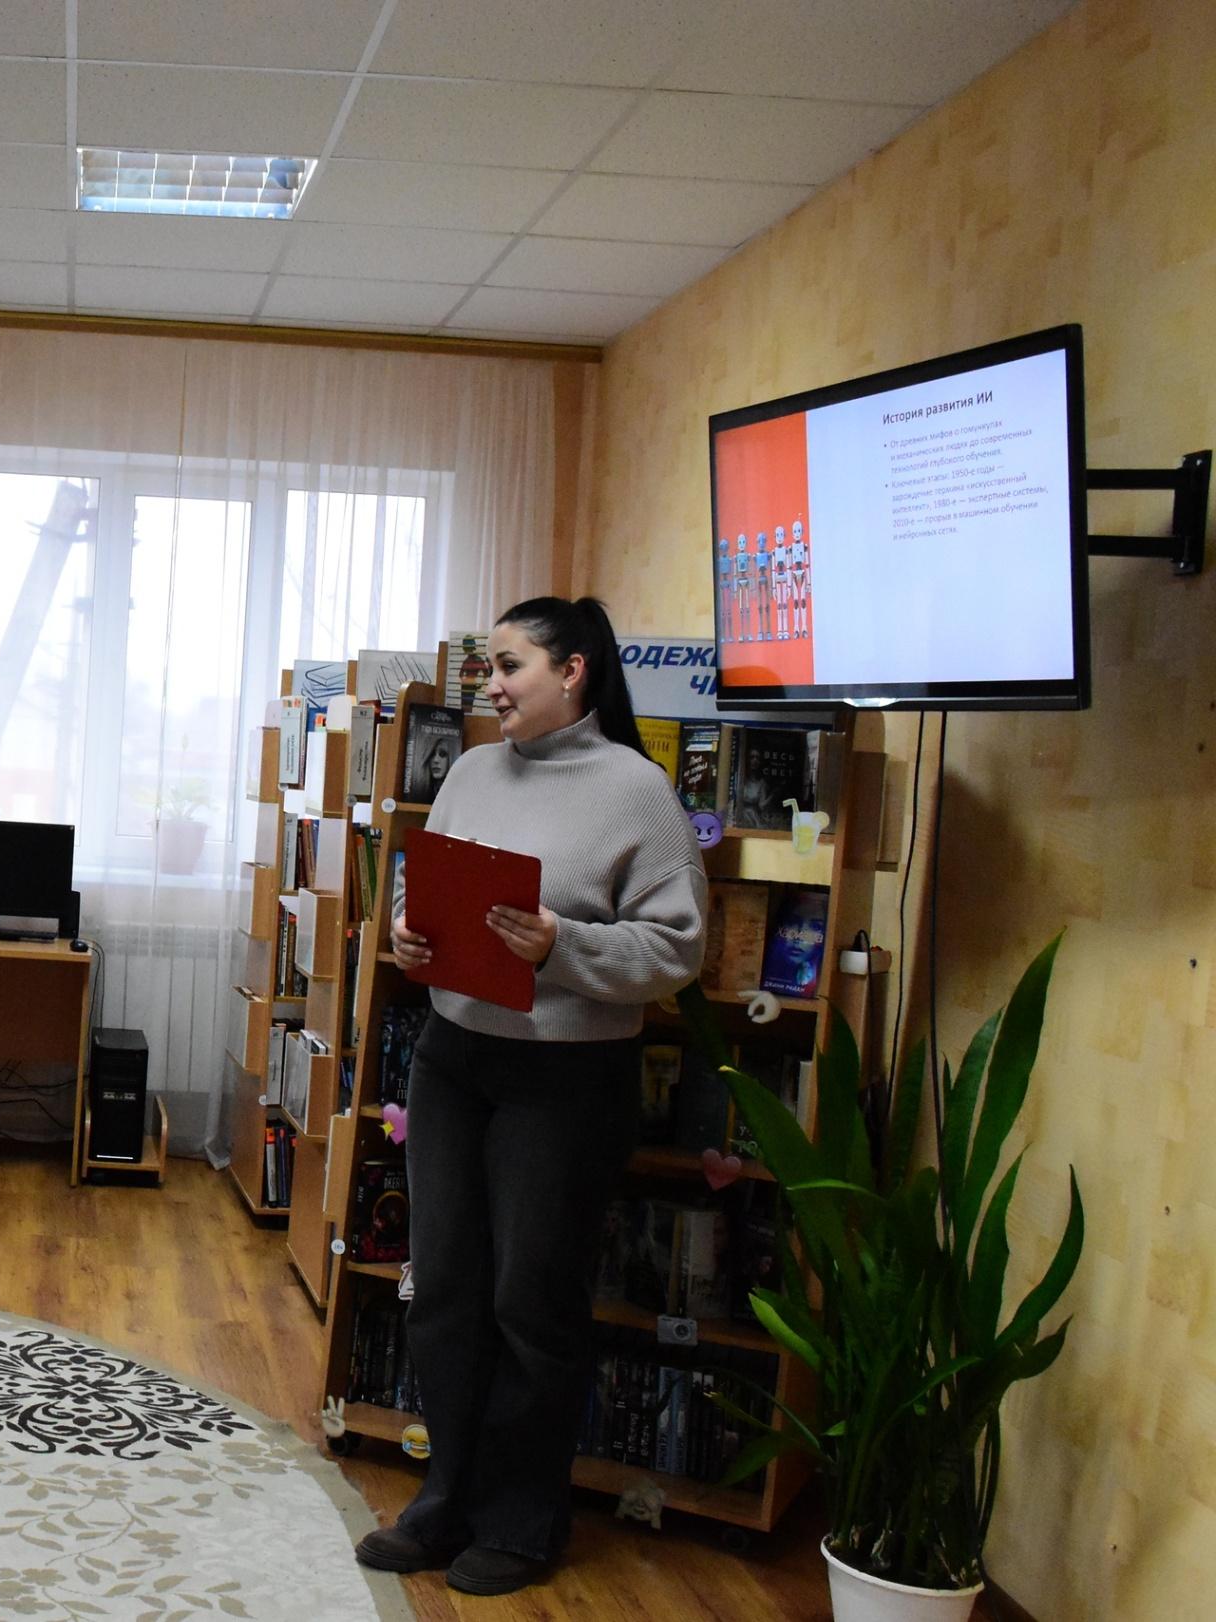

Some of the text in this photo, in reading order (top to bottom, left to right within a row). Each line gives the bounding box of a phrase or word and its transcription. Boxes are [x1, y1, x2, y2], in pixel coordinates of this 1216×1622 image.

[883, 390, 993, 425] История развития ИИ
[930, 429, 953, 441] мифов
[969, 439, 979, 448] до
[981, 428, 1032, 445] современных
[977, 465, 996, 474] годы
[968, 491, 1012, 503] экспертные
